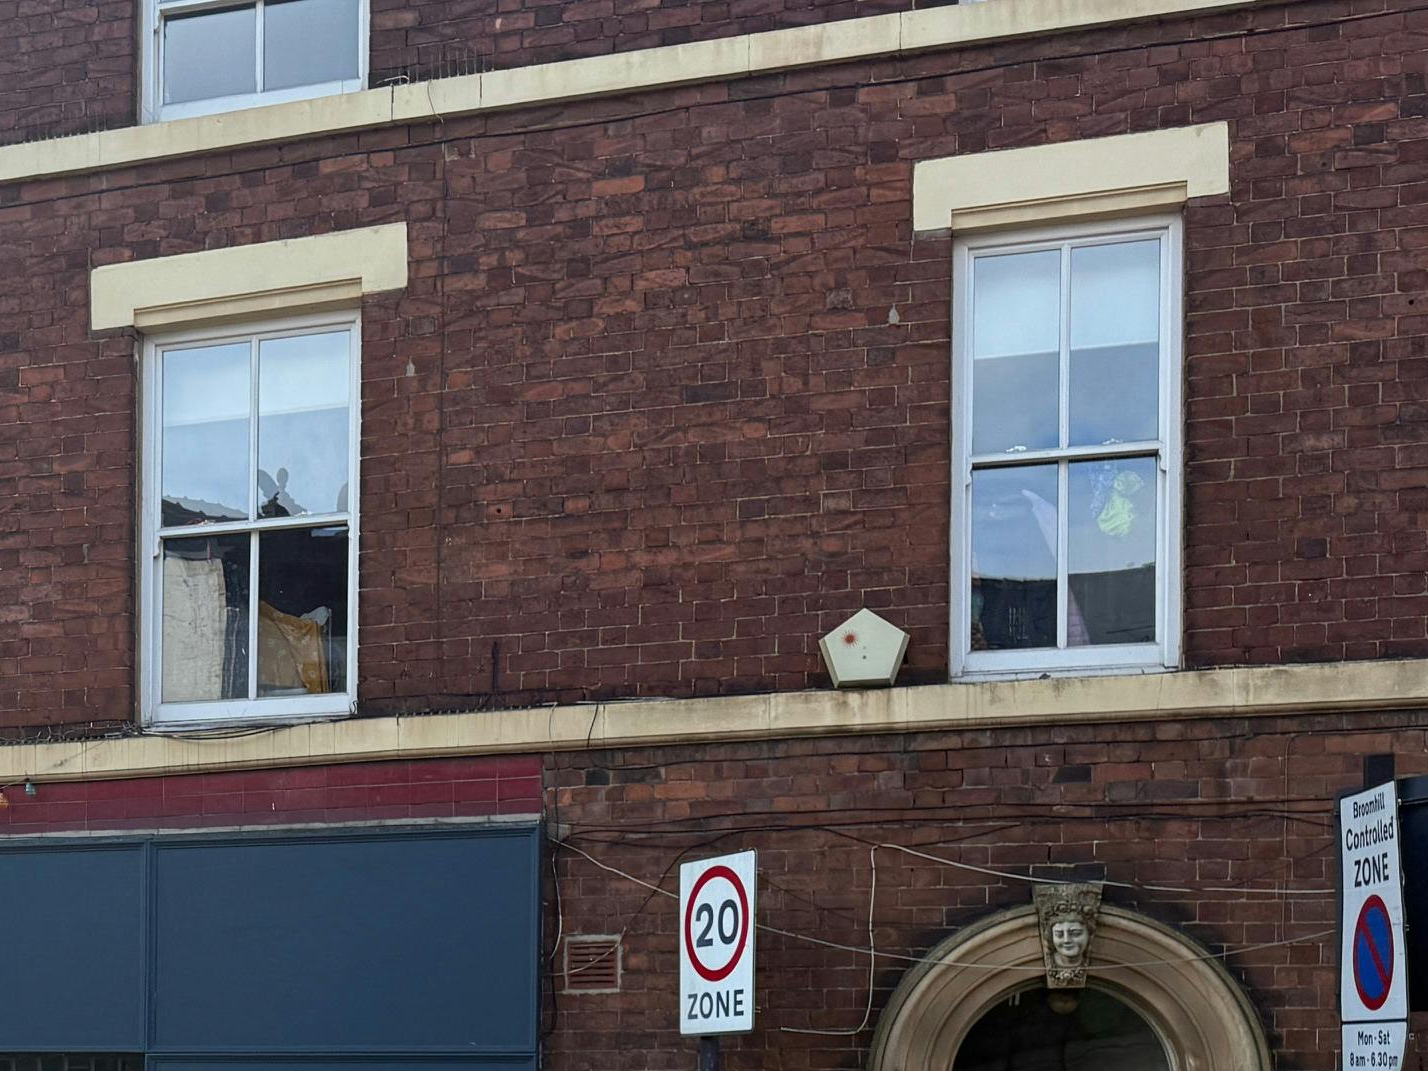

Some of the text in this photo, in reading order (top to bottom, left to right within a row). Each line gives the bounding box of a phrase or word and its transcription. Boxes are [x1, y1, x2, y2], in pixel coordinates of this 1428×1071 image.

[1353, 792, 1385, 819] Broomhill
[1345, 816, 1394, 851] Controlled
[1354, 852, 1390, 888] ZONE
[695, 899, 739, 948] 20
[687, 989, 744, 1020] ZONE
